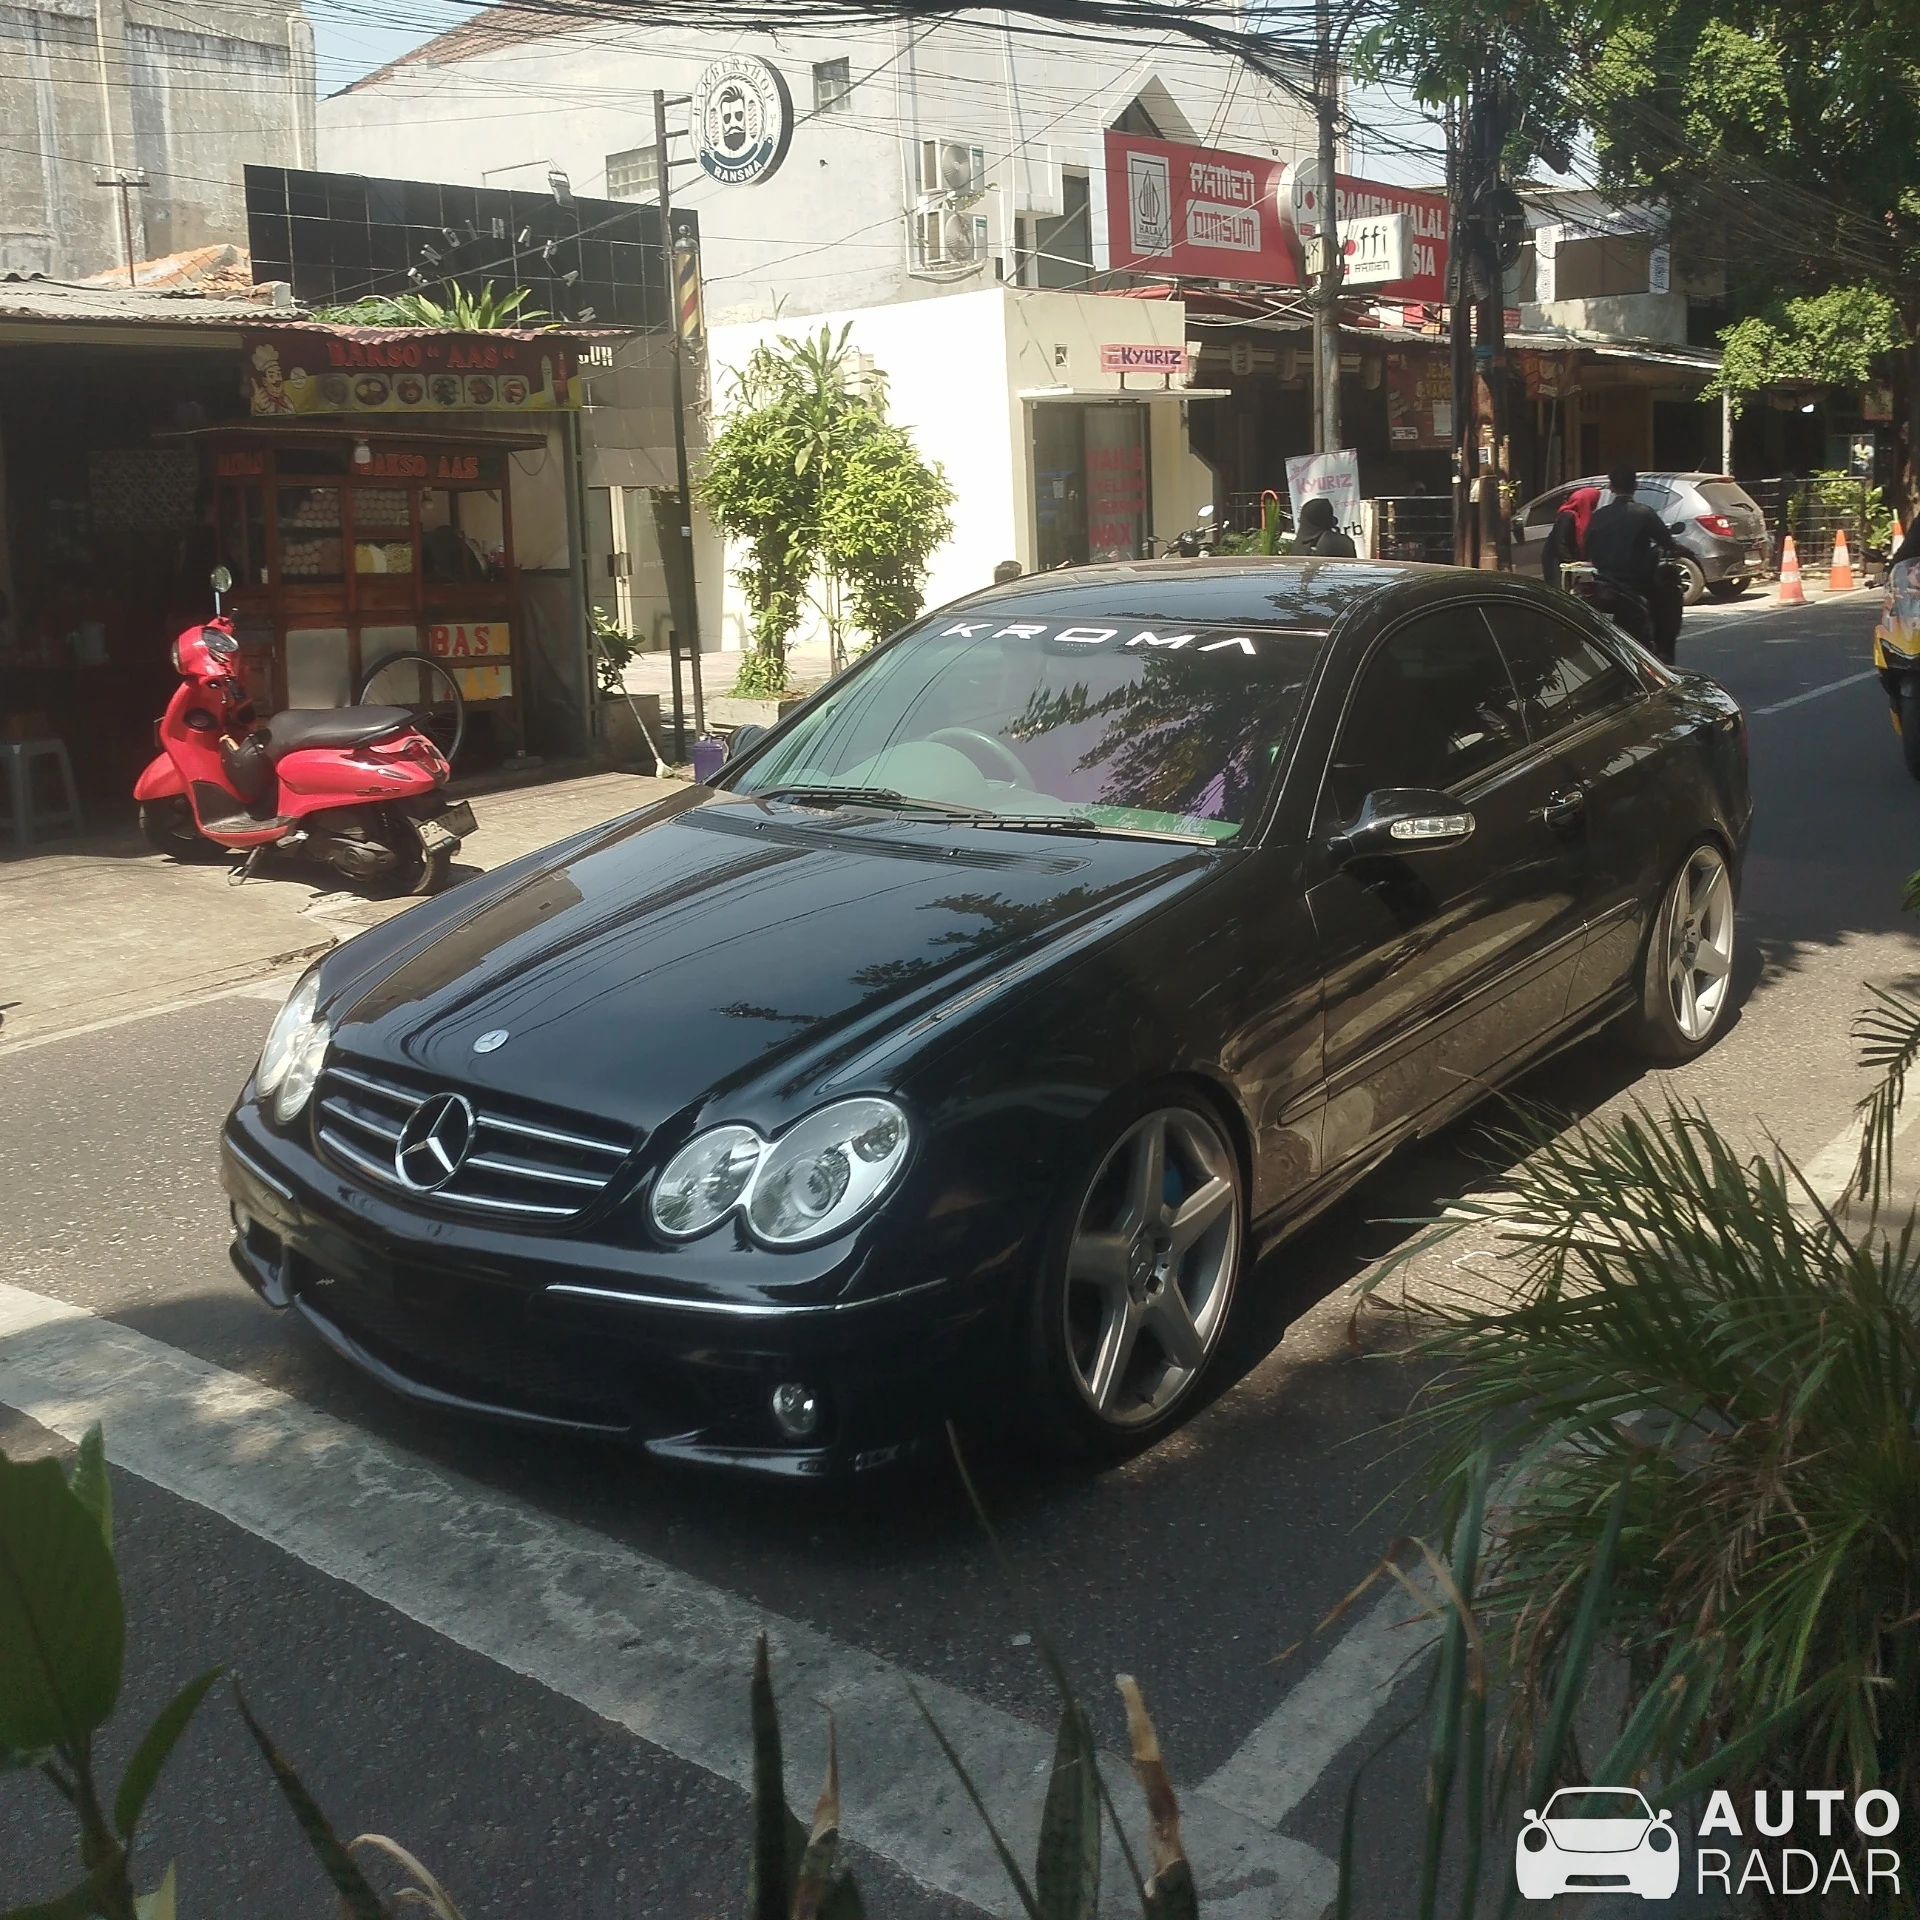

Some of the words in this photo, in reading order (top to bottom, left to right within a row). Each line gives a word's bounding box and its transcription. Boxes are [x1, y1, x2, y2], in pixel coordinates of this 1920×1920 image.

[713, 160, 763, 182] RANSMA
[327, 342, 421, 368] BAKSO
[1121, 347, 1182, 365] KYURIZ
[438, 456, 479, 479] AAS
[1295, 473, 1353, 494] KYURIZ
[1090, 522, 1133, 547] WAX
[939, 622, 1257, 655] KROMA
